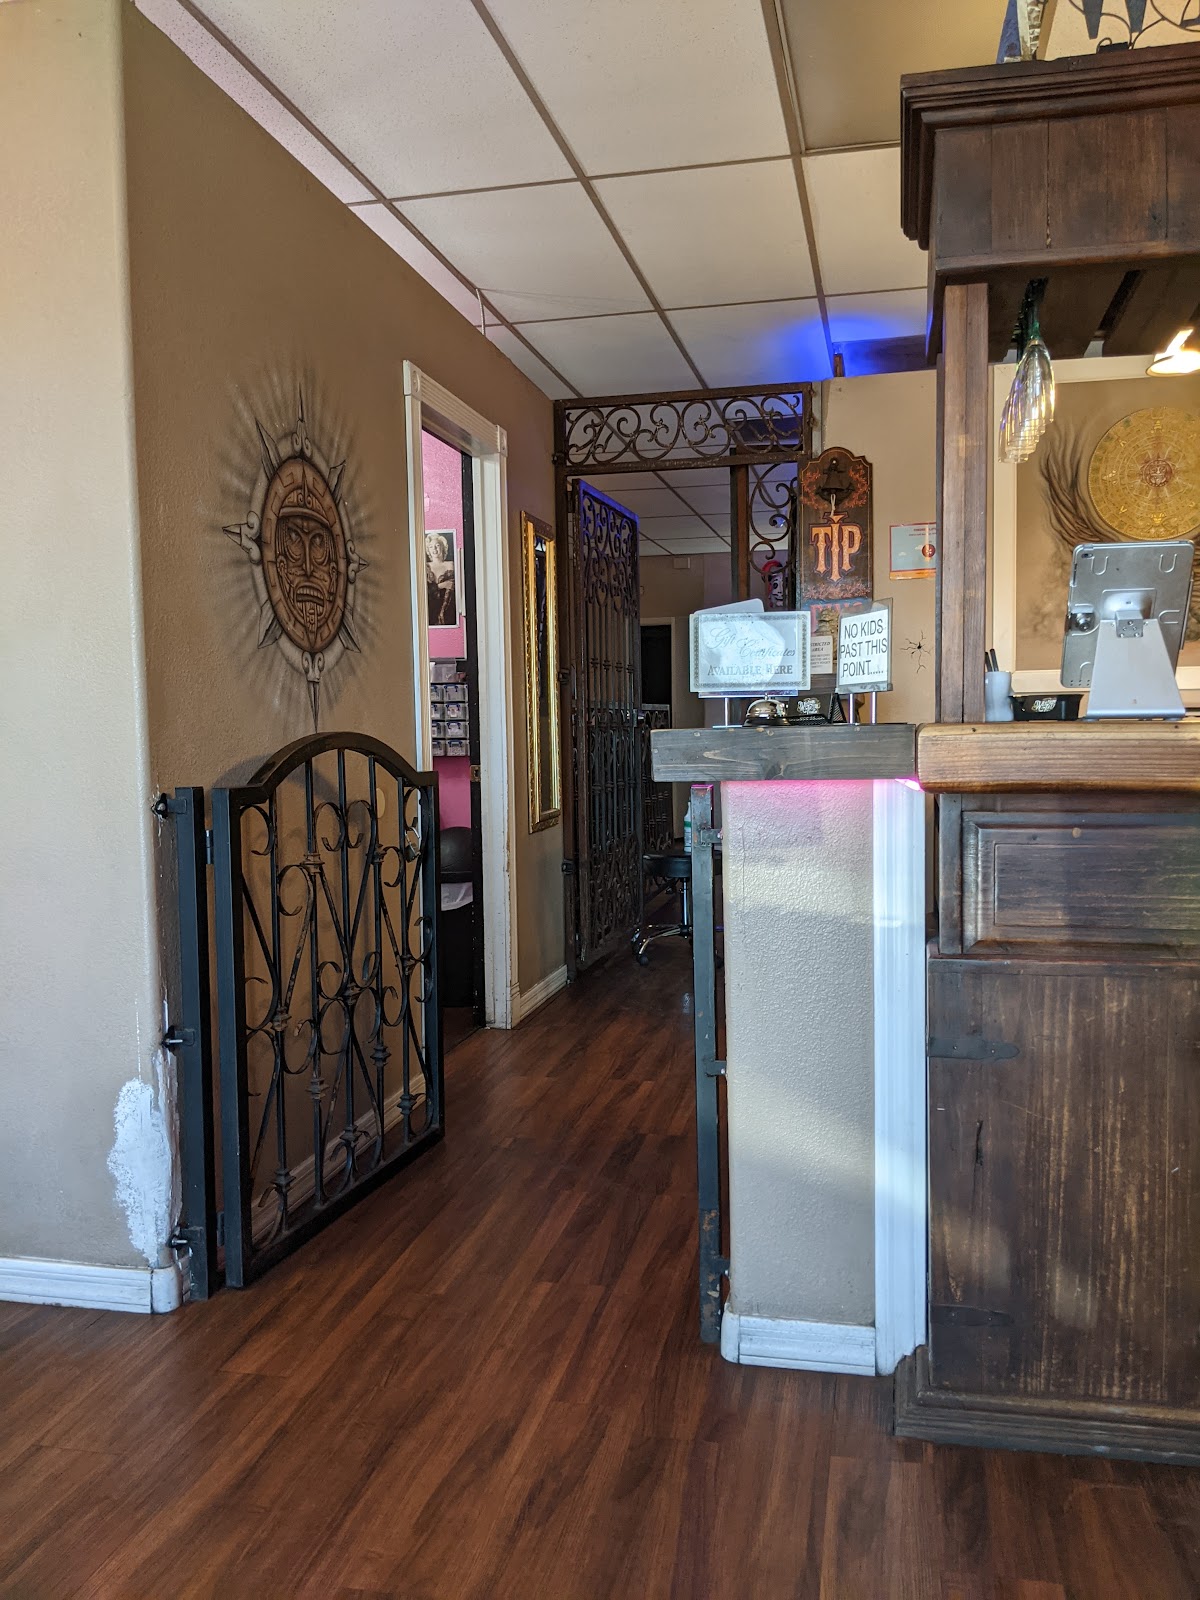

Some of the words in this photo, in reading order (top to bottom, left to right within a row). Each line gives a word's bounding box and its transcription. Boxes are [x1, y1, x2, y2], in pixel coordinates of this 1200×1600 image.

[810, 513, 863, 583] TIP
[706, 628, 736, 649] Gift
[844, 624, 858, 640] NO
[861, 619, 884, 637] KIDS
[736, 638, 796, 659] Certificates
[840, 642, 863, 659] PAST
[865, 638, 888, 655] THIS
[707, 664, 762, 676] AVAILABLE
[765, 664, 793, 675] HERE
